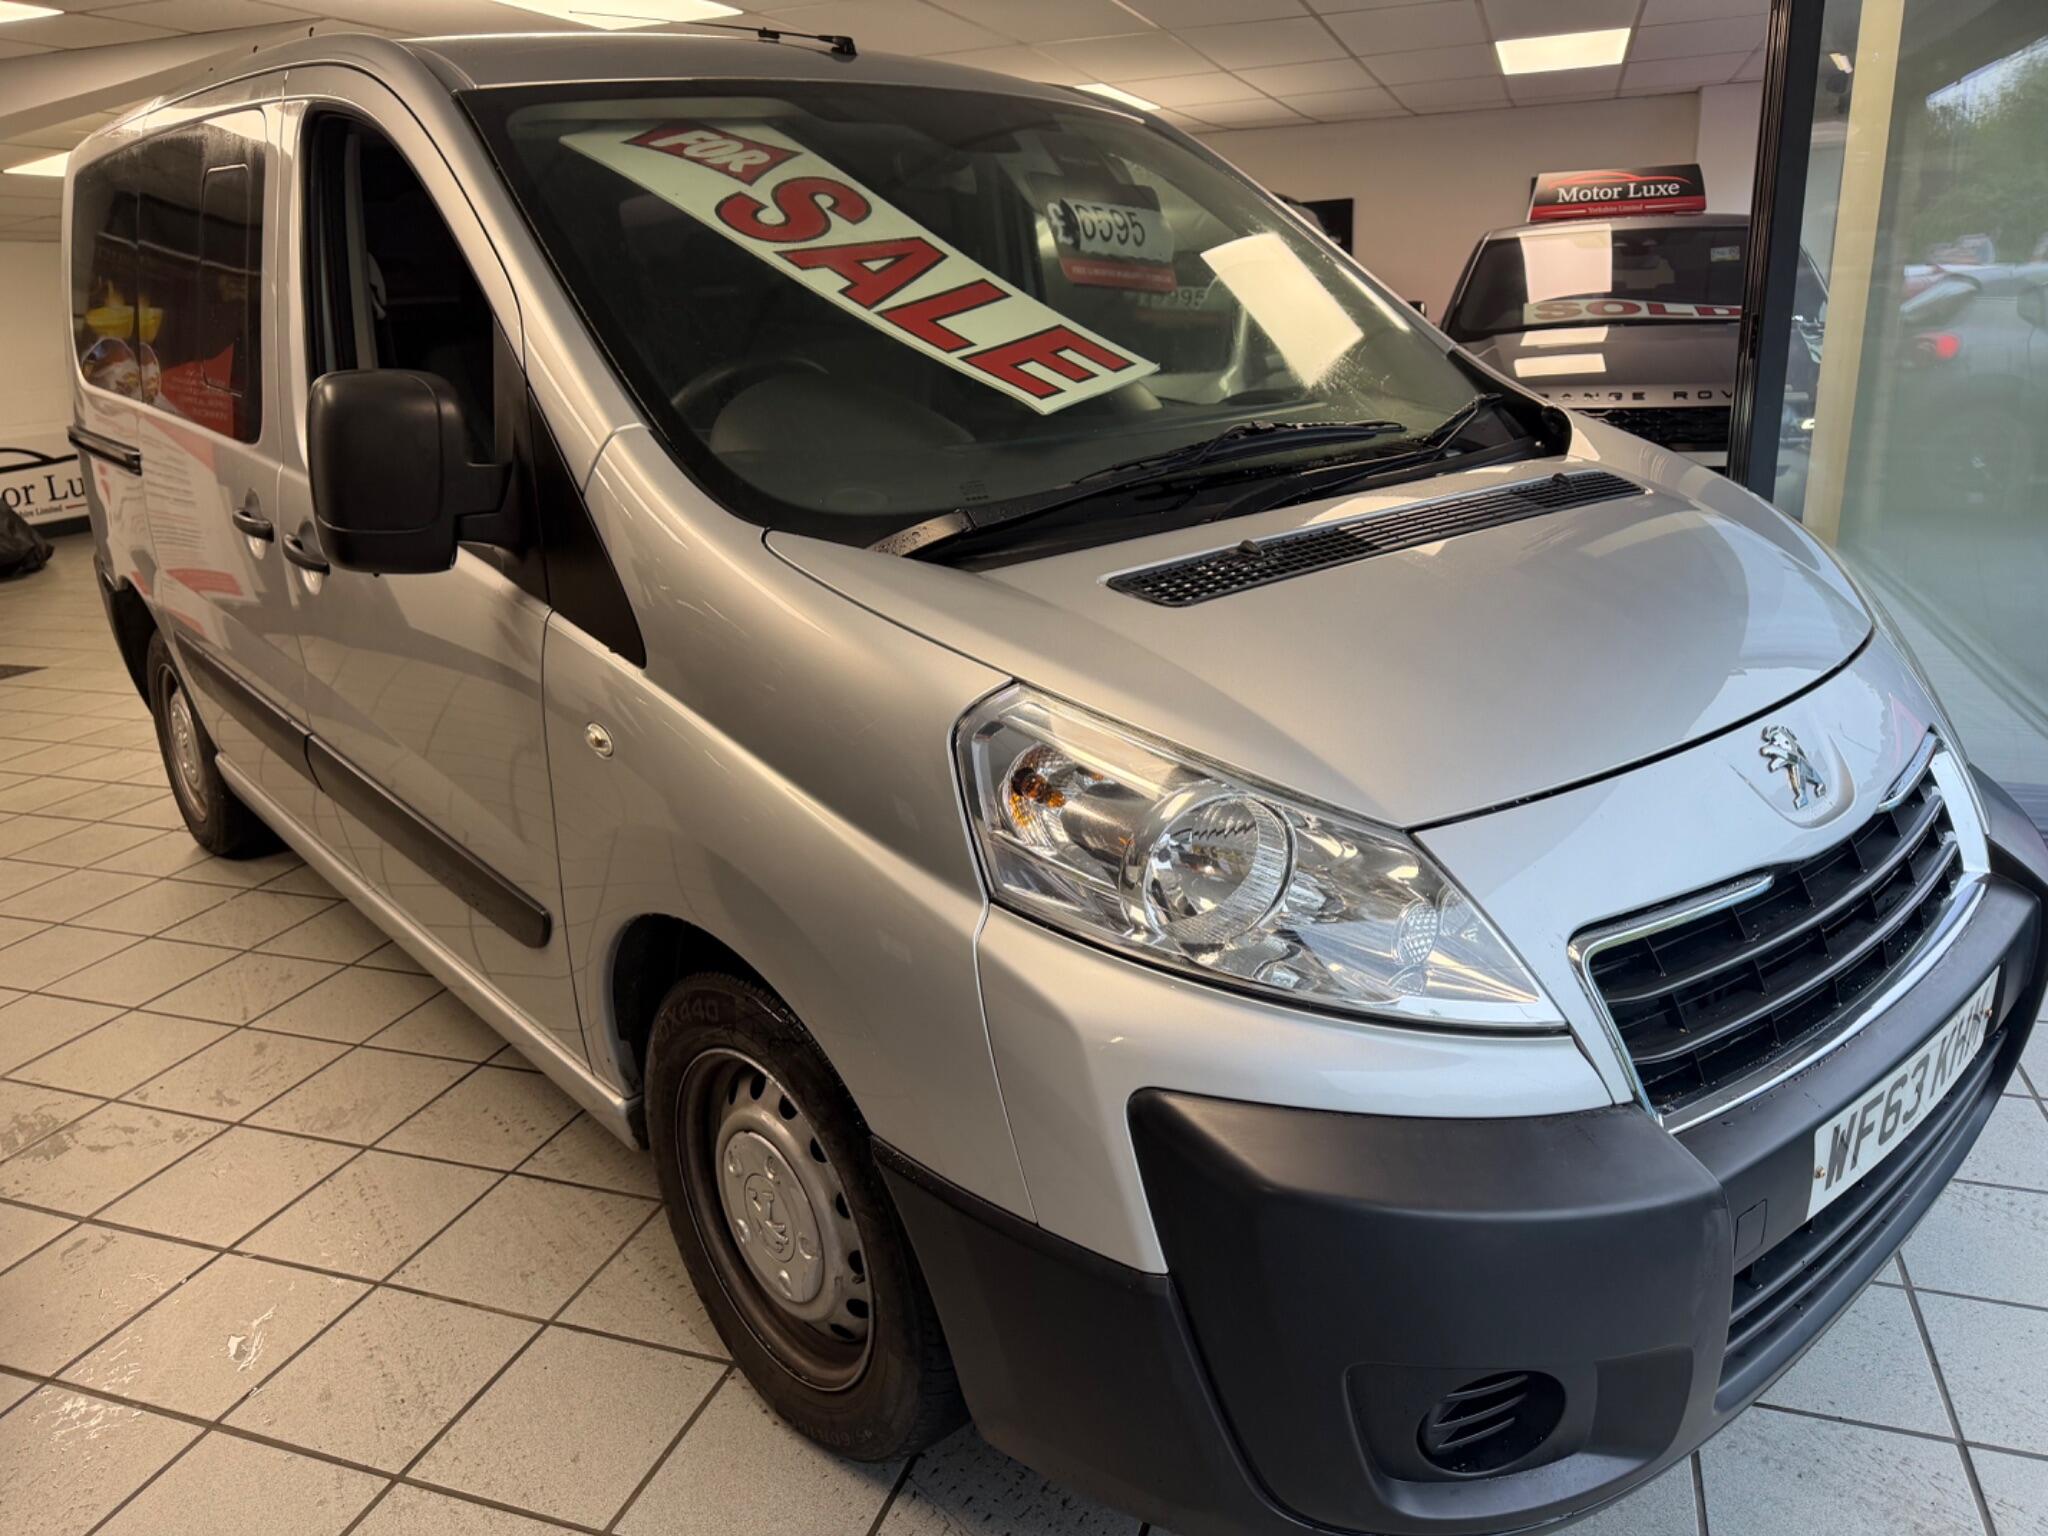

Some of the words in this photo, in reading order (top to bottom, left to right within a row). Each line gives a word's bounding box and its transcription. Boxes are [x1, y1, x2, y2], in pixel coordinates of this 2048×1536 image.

[648, 129, 771, 173] FOR
[1557, 187, 1623, 203] Motor
[1628, 182, 1681, 198] Luxe
[715, 176, 1135, 399] SALE
[1533, 300, 1742, 320] SOLD
[1674, 390, 1733, 401] ROV
[43, 474, 86, 502] Lu
[1825, 1053, 1930, 1191] WF63
